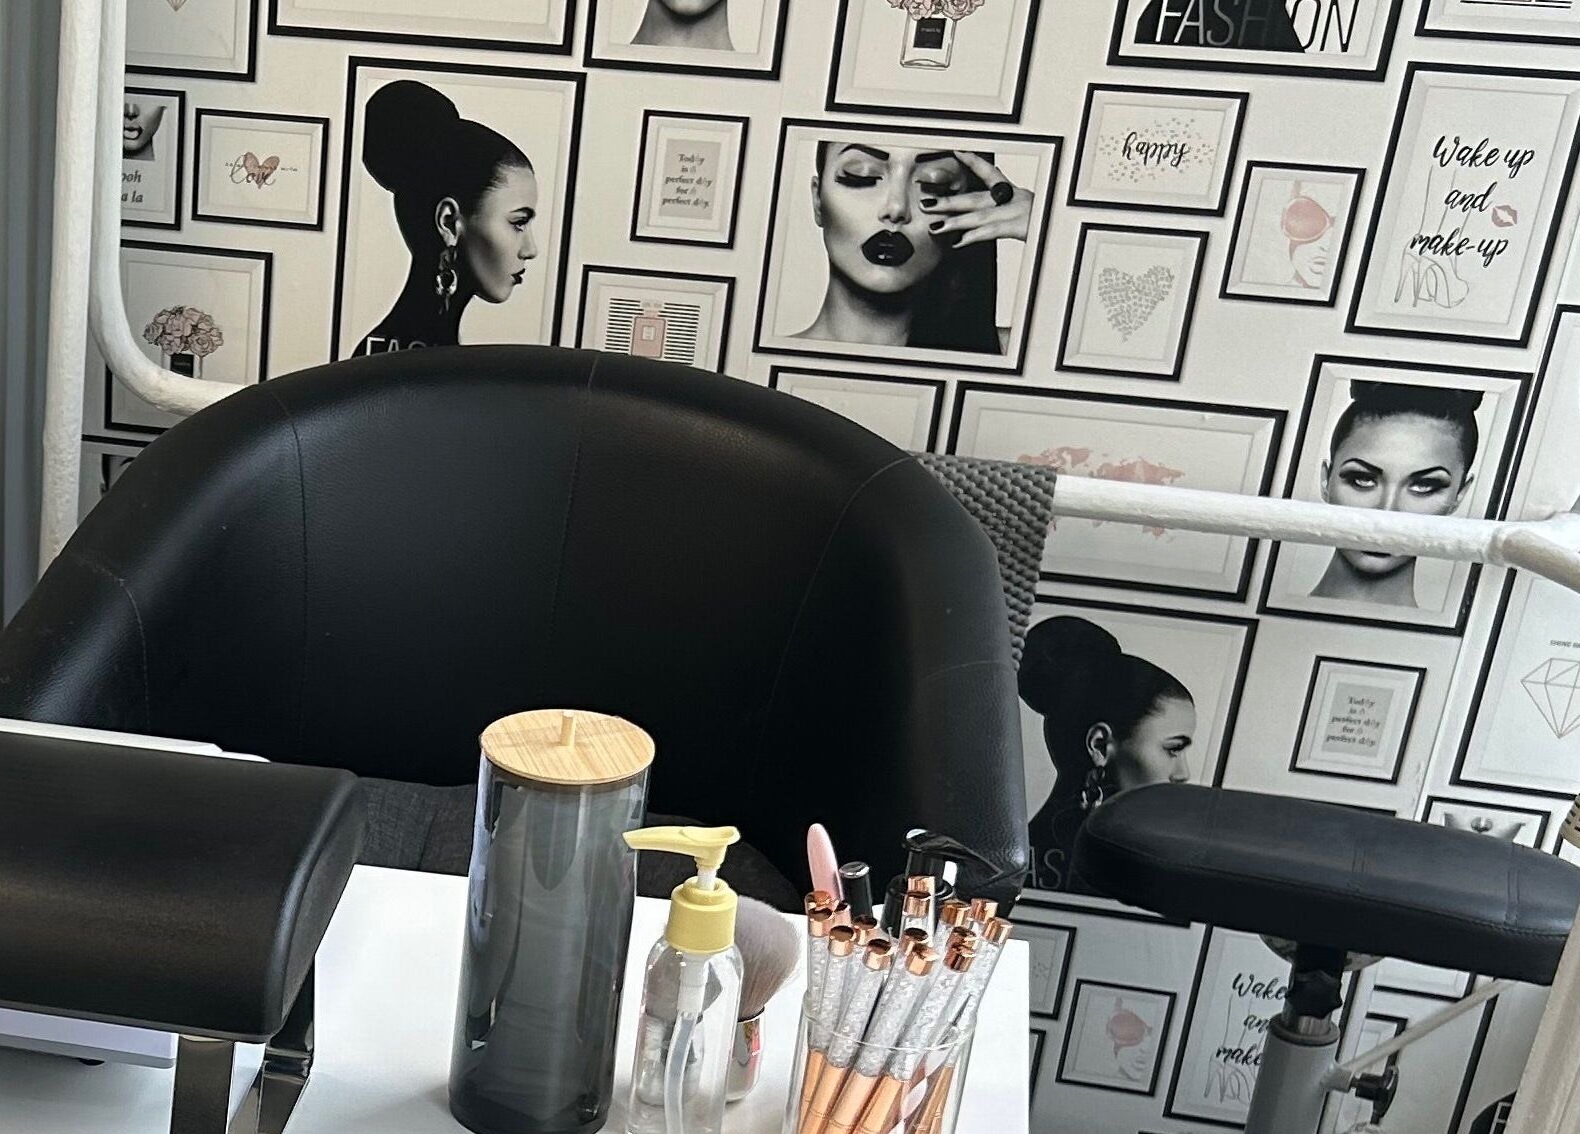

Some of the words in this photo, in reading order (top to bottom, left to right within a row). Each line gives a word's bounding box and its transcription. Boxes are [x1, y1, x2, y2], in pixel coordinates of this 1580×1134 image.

[1155, 0, 1360, 53] FASHON
[1122, 131, 1191, 168] happy
[1432, 135, 1501, 168] Wake
[1504, 149, 1536, 180] up
[1444, 181, 1498, 213] and
[1410, 227, 1510, 268] make-up
[1243, 1013, 1271, 1032] an
